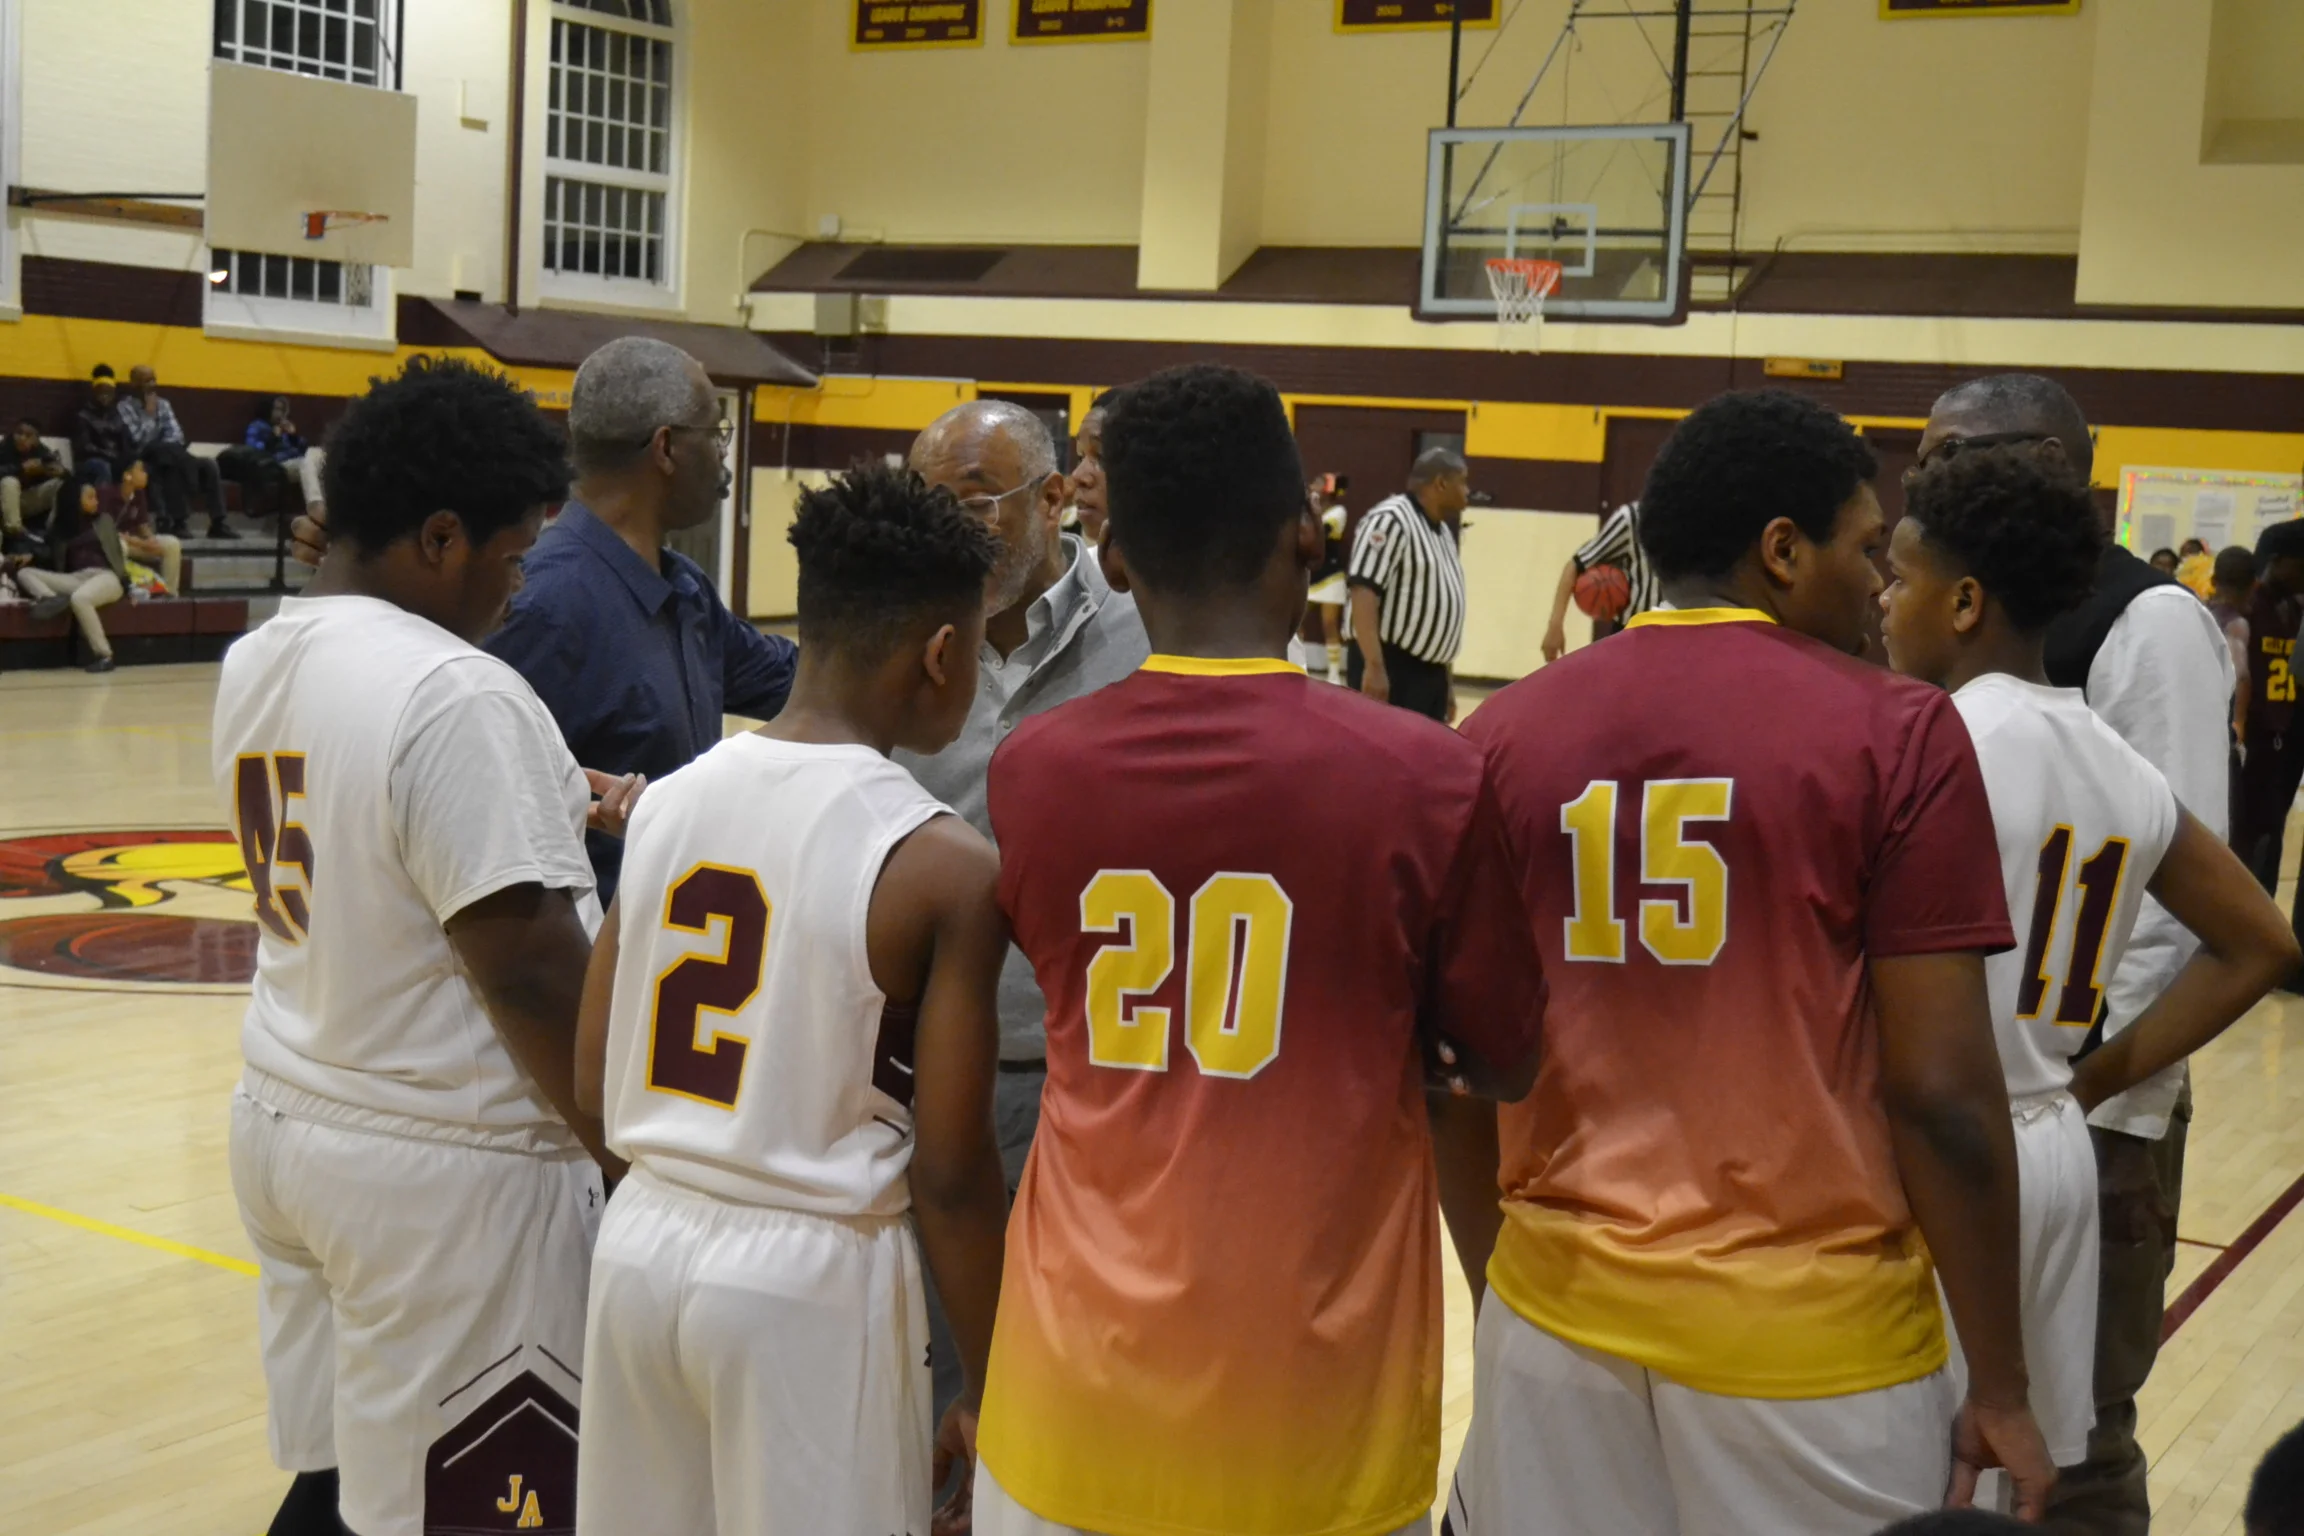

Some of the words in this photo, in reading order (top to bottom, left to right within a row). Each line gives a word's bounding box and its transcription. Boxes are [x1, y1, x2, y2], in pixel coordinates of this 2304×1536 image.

[1560, 778, 1734, 966] 15
[2015, 823, 2131, 1027] 11
[645, 860, 773, 1112] 2
[1079, 869, 1293, 1080] 20
[497, 1474, 543, 1528] JA
